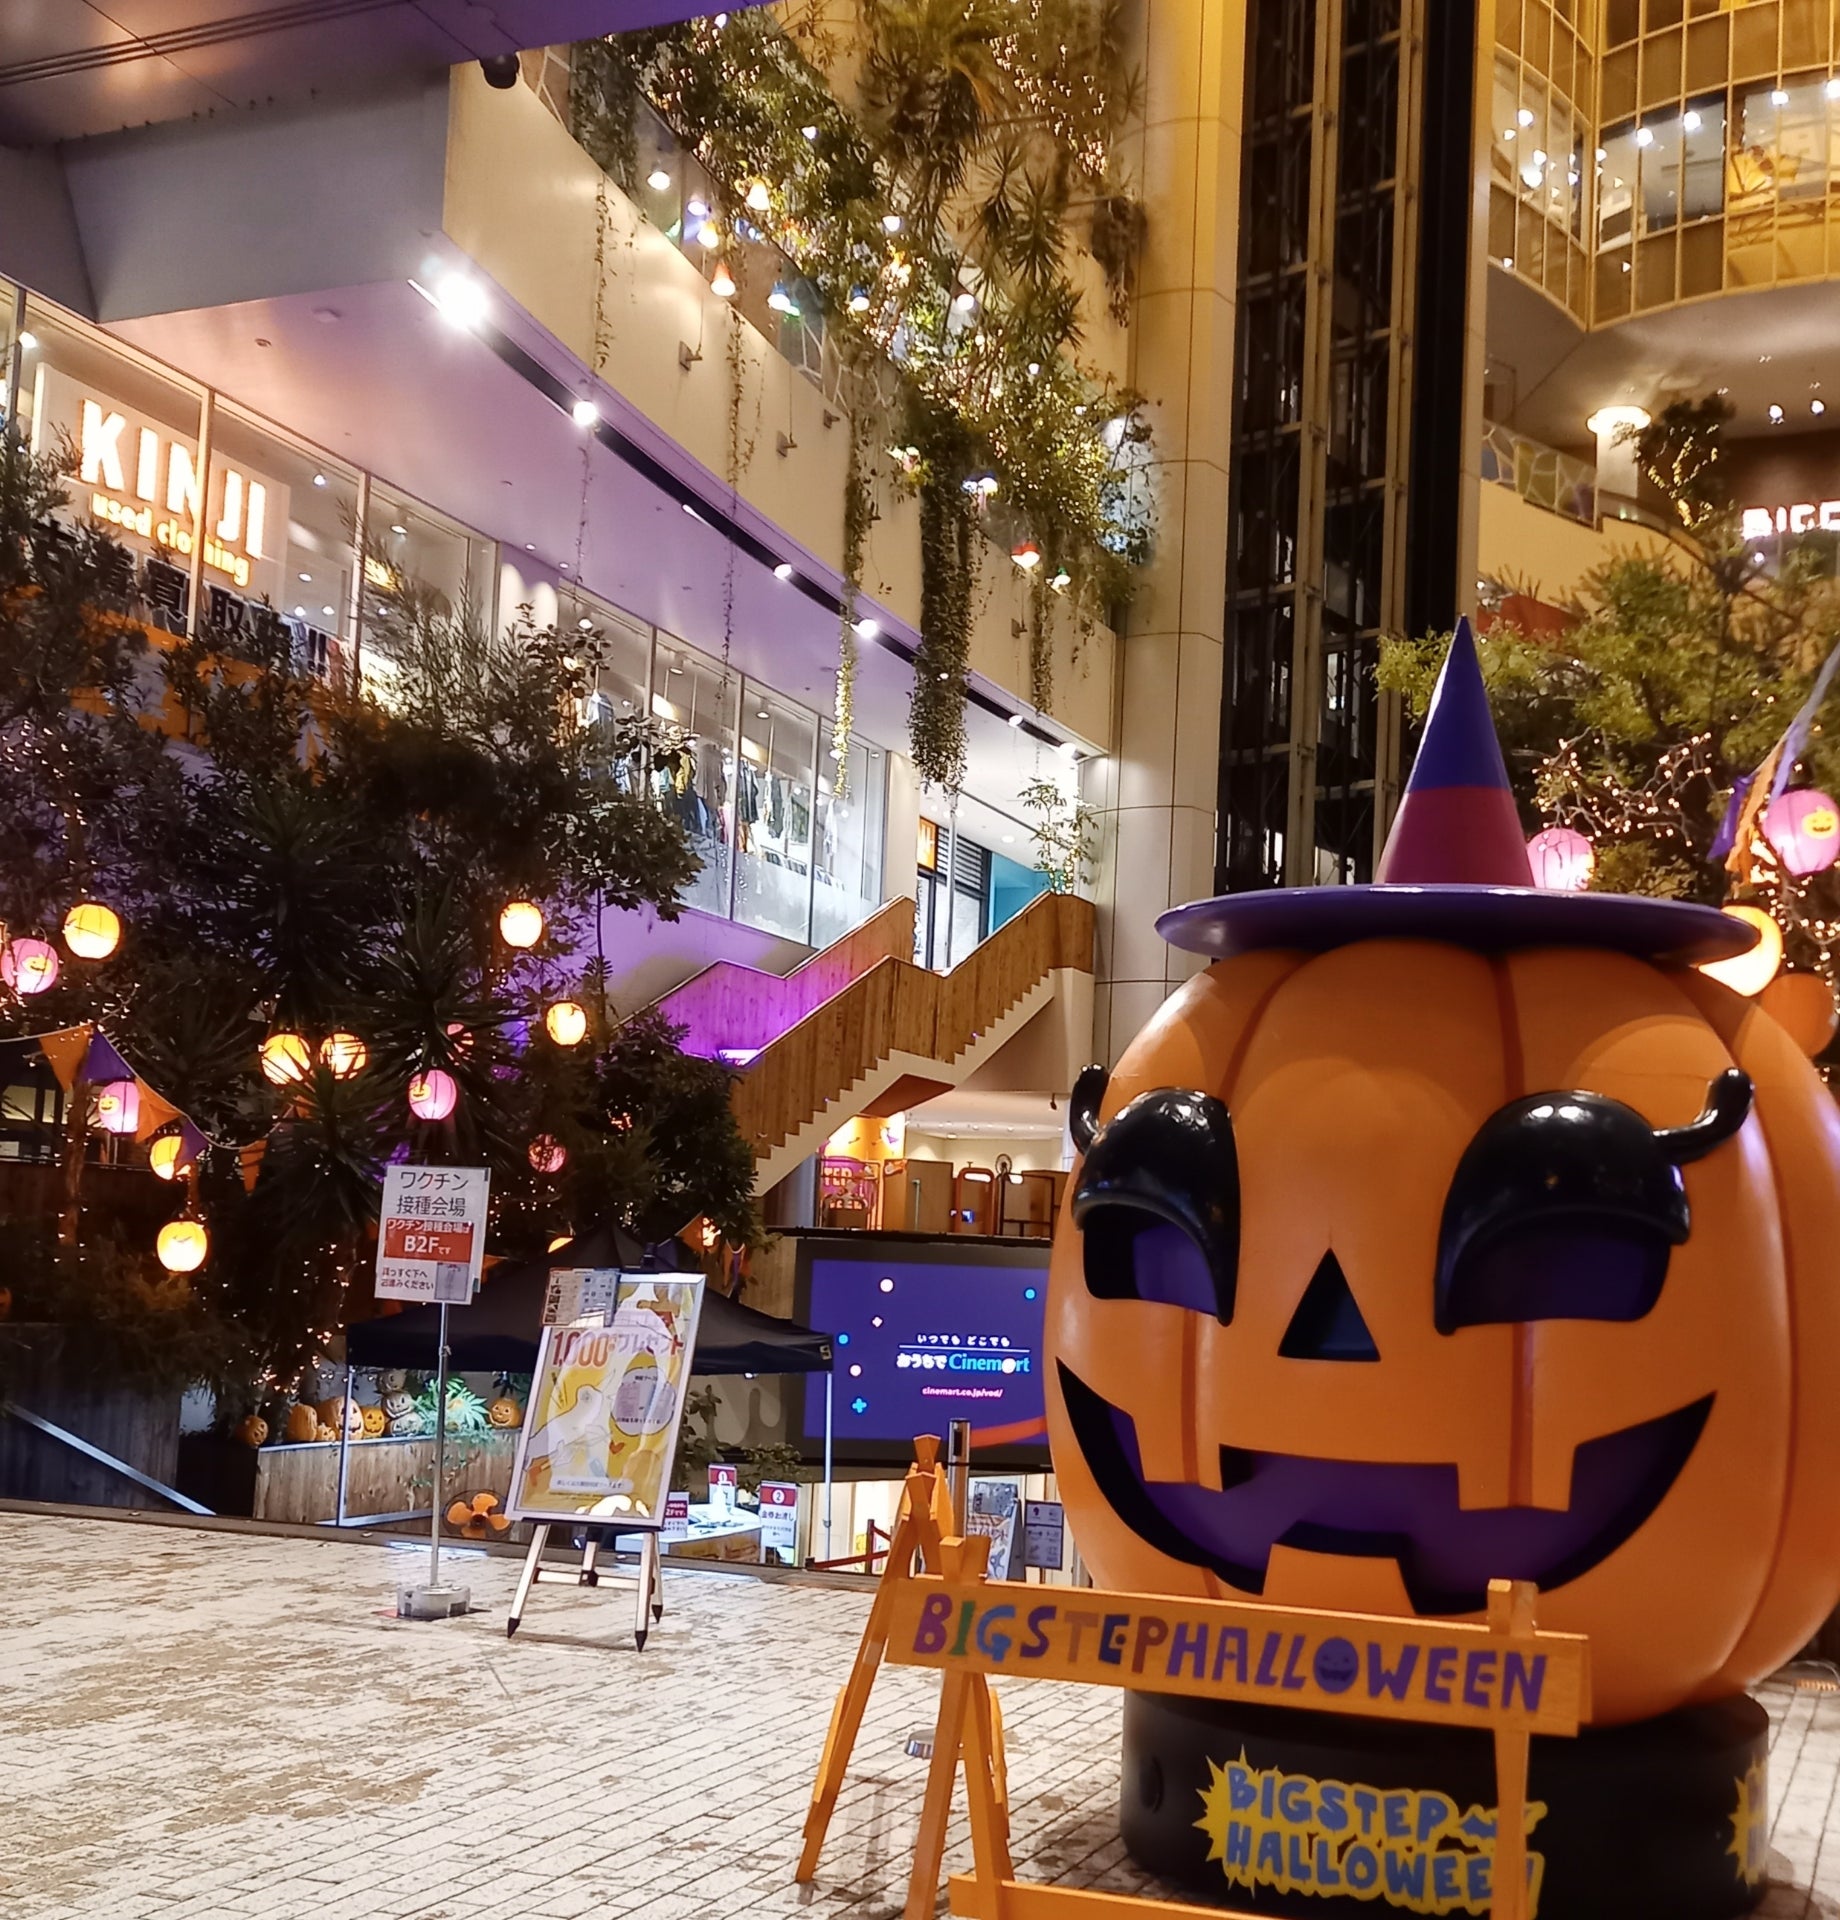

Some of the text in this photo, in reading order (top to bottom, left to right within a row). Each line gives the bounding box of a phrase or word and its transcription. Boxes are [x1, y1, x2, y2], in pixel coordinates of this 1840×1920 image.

[80, 399, 266, 559] KINJI
[91, 492, 250, 587] used clohing
[396, 1195, 467, 1217] 接種会場
[400, 1171, 469, 1191] ワクチン
[404, 1235, 452, 1255] B2Fです
[1228, 1767, 1449, 1841] BIGSTEP
[1226, 1821, 1534, 1900] HALLOWEE
